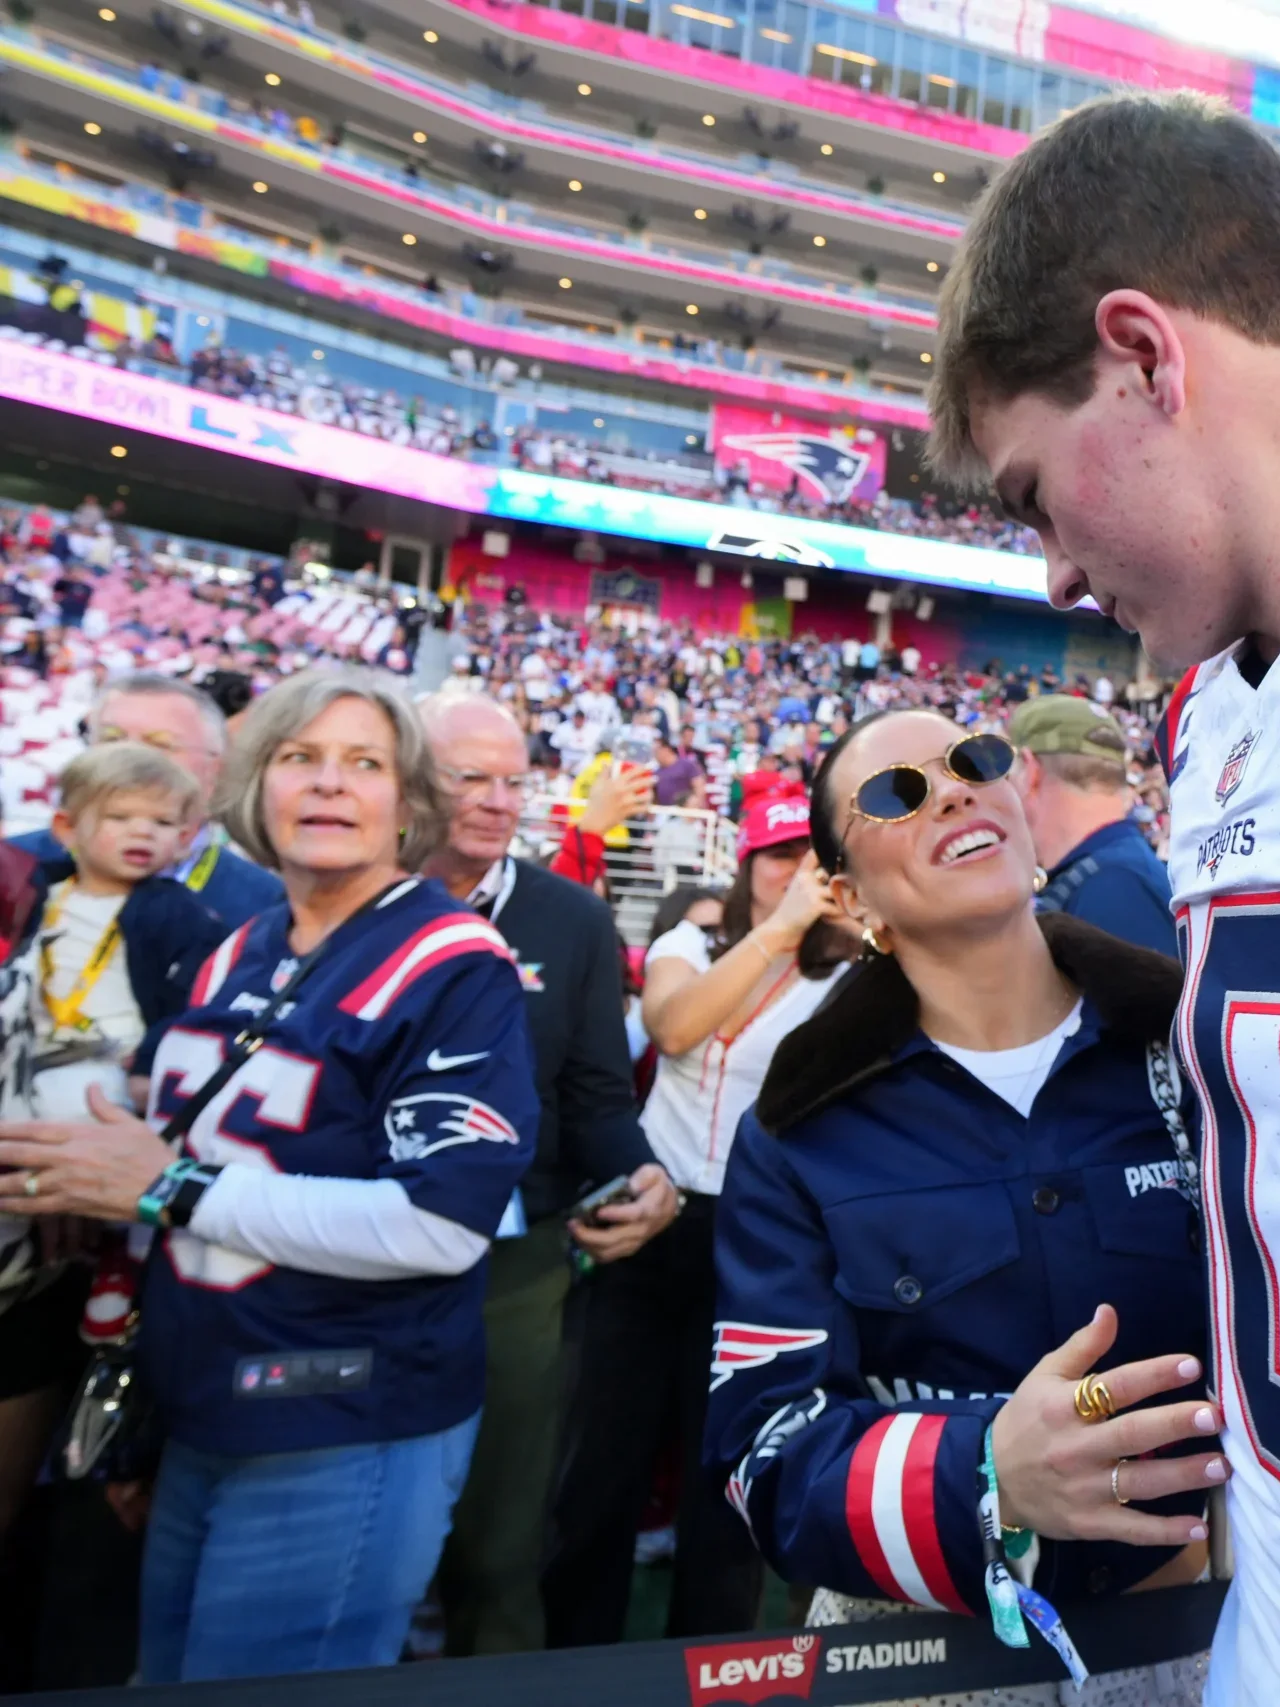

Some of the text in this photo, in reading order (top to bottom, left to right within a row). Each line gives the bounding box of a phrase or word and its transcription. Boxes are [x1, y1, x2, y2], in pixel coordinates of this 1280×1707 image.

[190, 404, 298, 456] LX
[1197, 817, 1256, 878] PATRIOTS
[1124, 1160, 1186, 1198] PATRI
[825, 1637, 947, 1674] STADIUM
